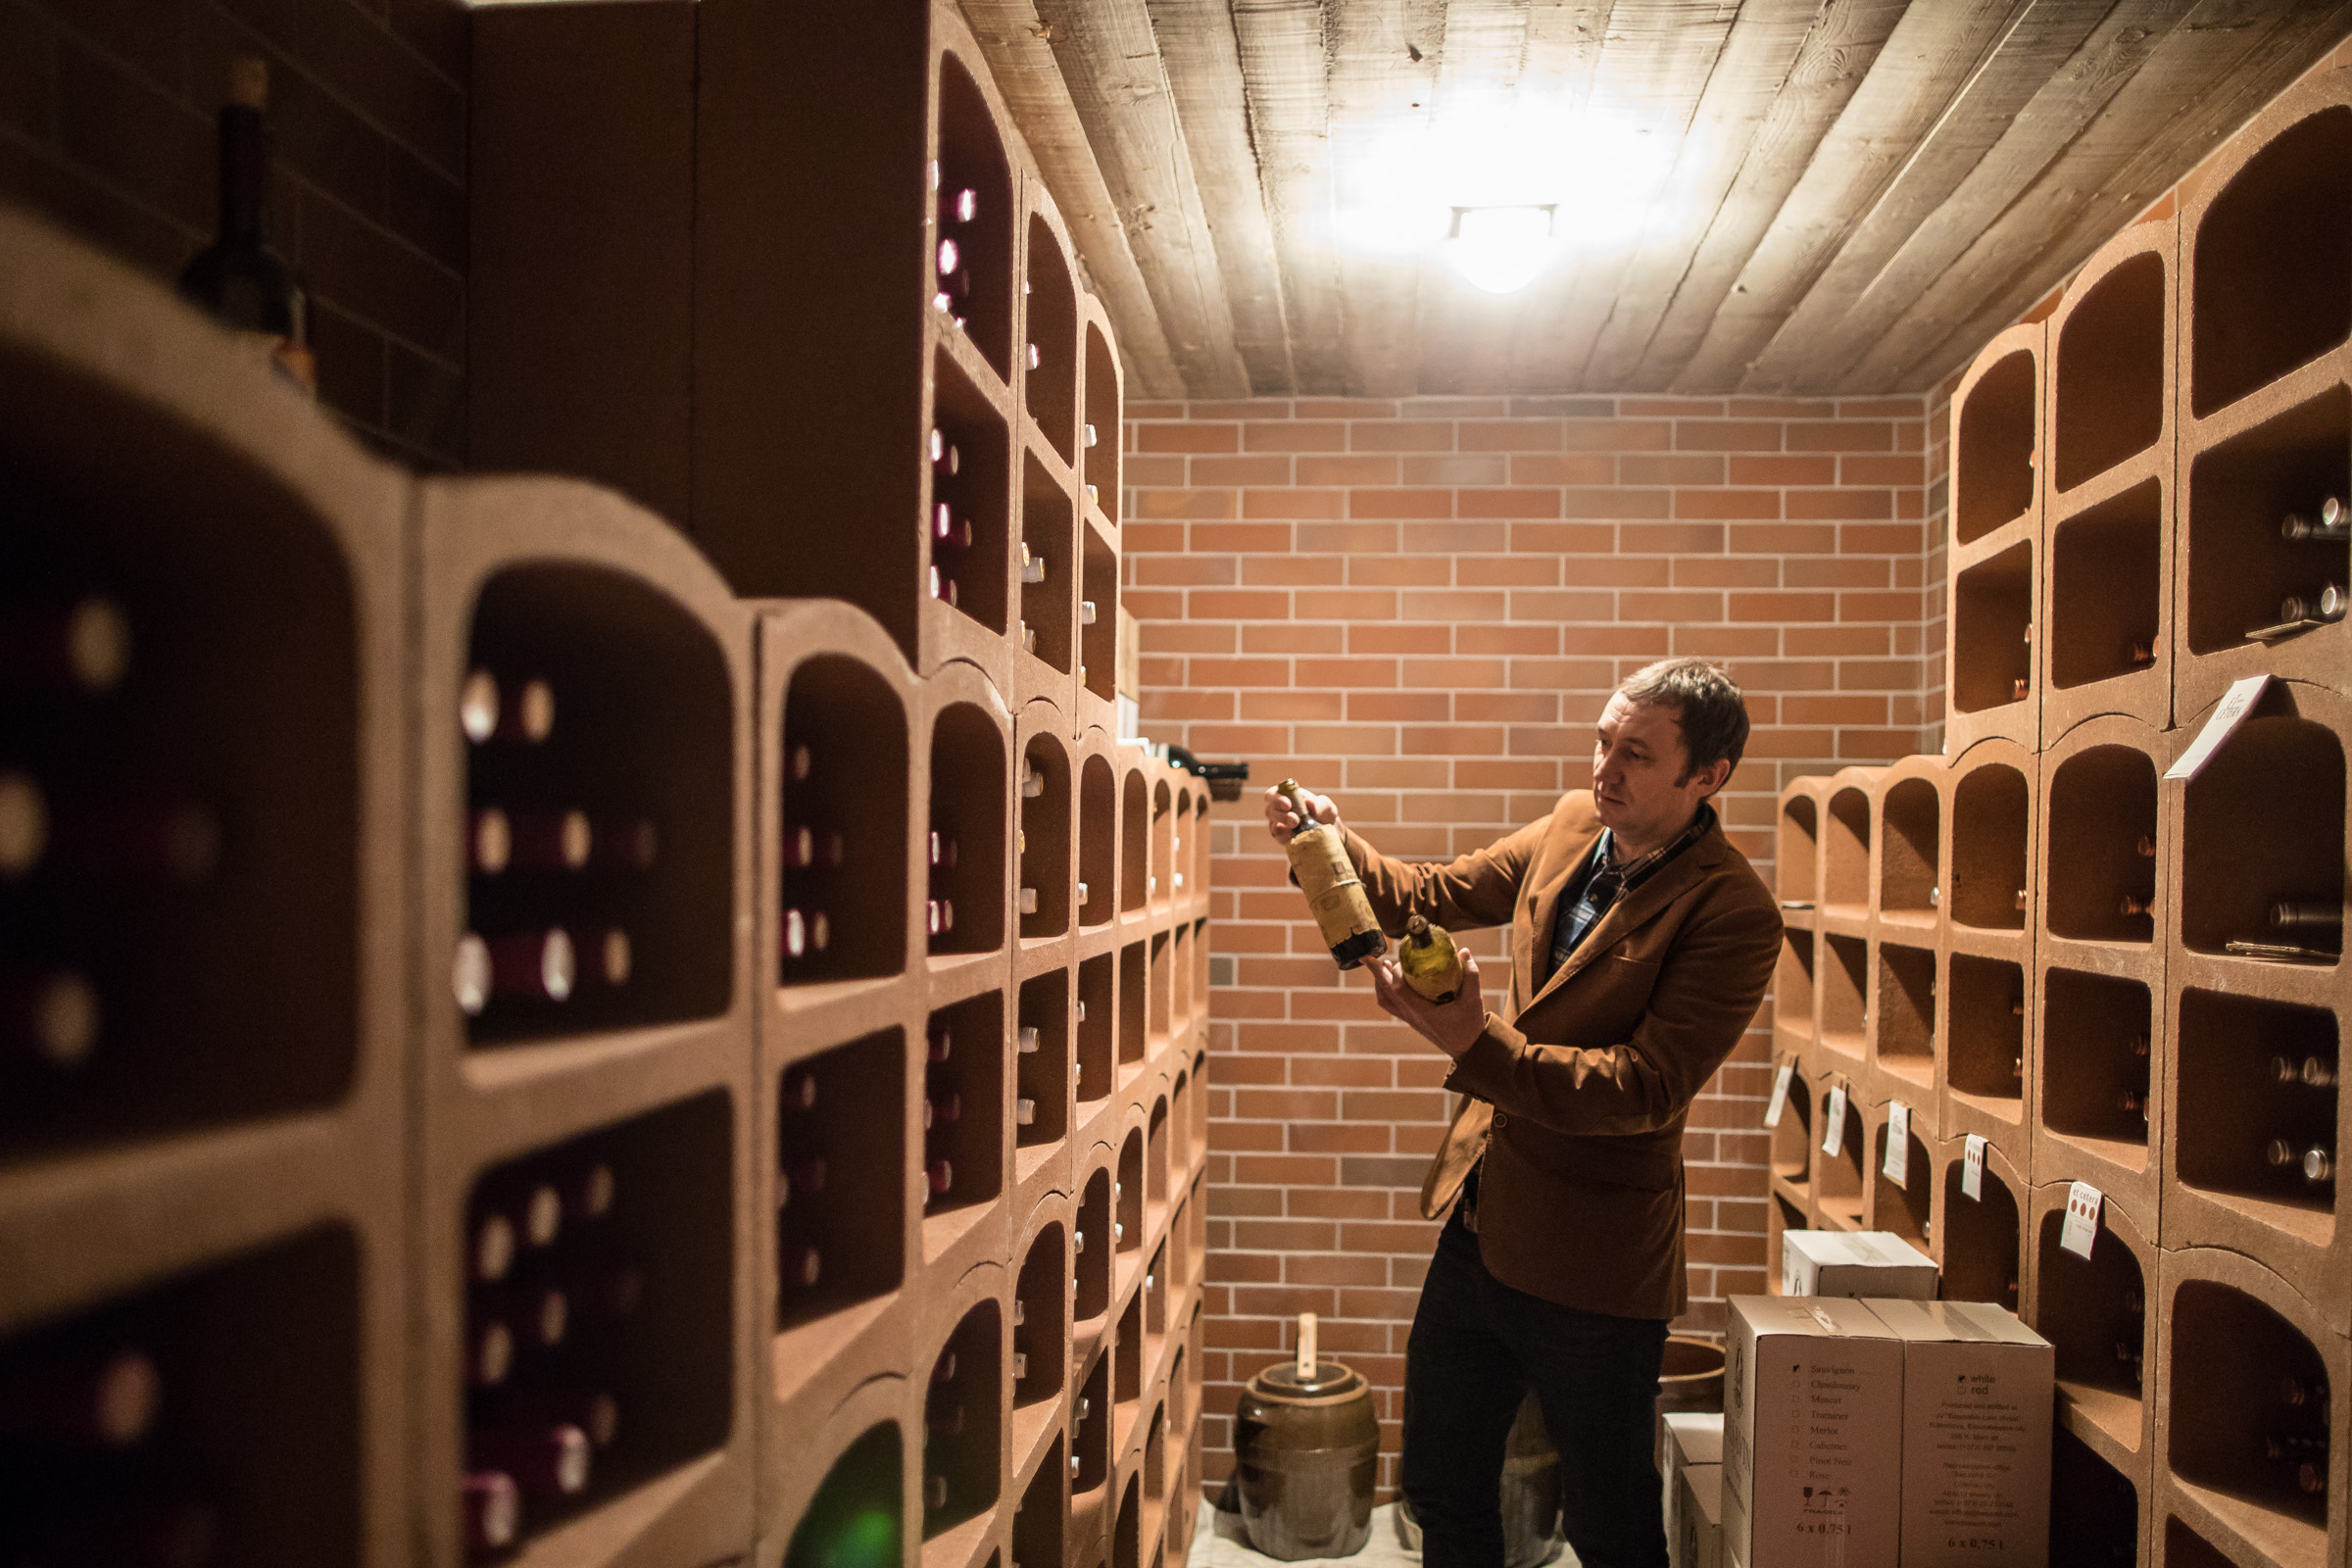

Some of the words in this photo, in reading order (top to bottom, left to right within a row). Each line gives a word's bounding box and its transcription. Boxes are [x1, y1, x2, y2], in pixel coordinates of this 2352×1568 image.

[2073, 1188, 2079, 1198] et
[2080, 1191, 2098, 1205] cetera
[1810, 1364, 1855, 1376] Sauvignon
[1970, 1375, 1996, 1384] white
[1810, 1380, 1861, 1392] Chardonnay
[1970, 1385, 1989, 1395] red
[1811, 1395, 1842, 1404] Muscat
[1811, 1410, 1849, 1421] Traminer
[1810, 1426, 1838, 1435] Merlot
[1809, 1441, 1847, 1450] Cabernet
[1809, 1456, 1832, 1465] Pinot
[1834, 1457, 1853, 1466] Noir
[1796, 1522, 1804, 1533] 6
[1947, 1538, 1956, 1548] 6
